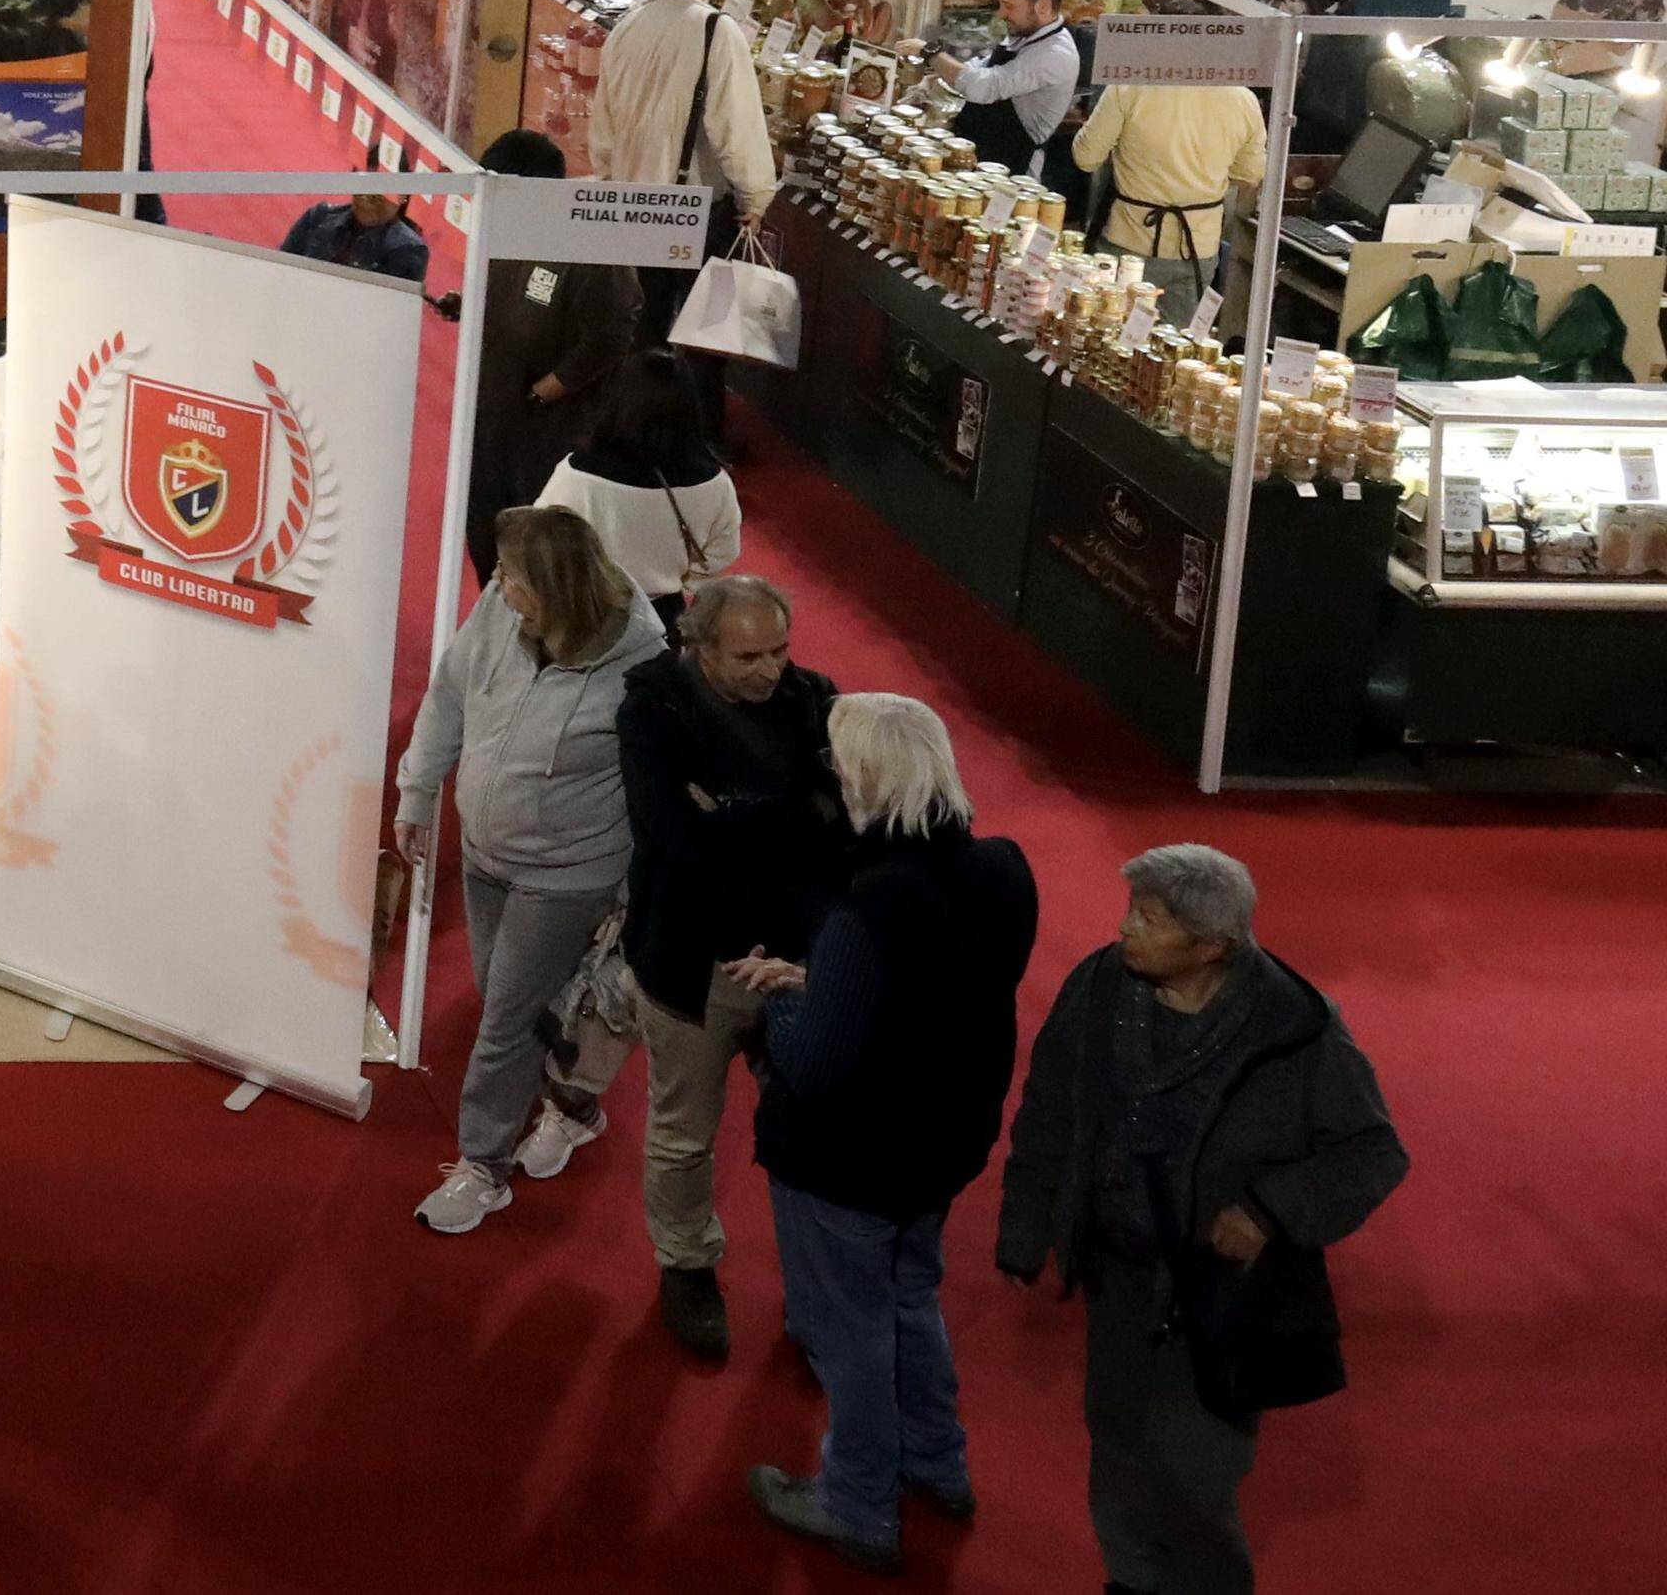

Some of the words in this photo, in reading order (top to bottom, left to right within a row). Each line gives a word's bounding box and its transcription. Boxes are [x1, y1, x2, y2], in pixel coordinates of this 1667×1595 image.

[1107, 22, 1166, 34] VALETTE
[1169, 23, 1202, 34] FOIE
[1205, 23, 1245, 36] GRAS
[1102, 64, 1259, 81] 113+114+118+119
[574, 189, 618, 203] CLUB
[622, 191, 702, 207] LIBERTAD
[570, 207, 619, 222] FILIAL
[624, 212, 699, 226] MONACO
[668, 244, 691, 259] 95
[175, 402, 218, 424] FILIAL
[167, 414, 227, 439] MONACO
[172, 469, 187, 491] C
[191, 493, 209, 517] L
[120, 563, 165, 591] CLUB
[168, 575, 255, 614] LIBERTAD
